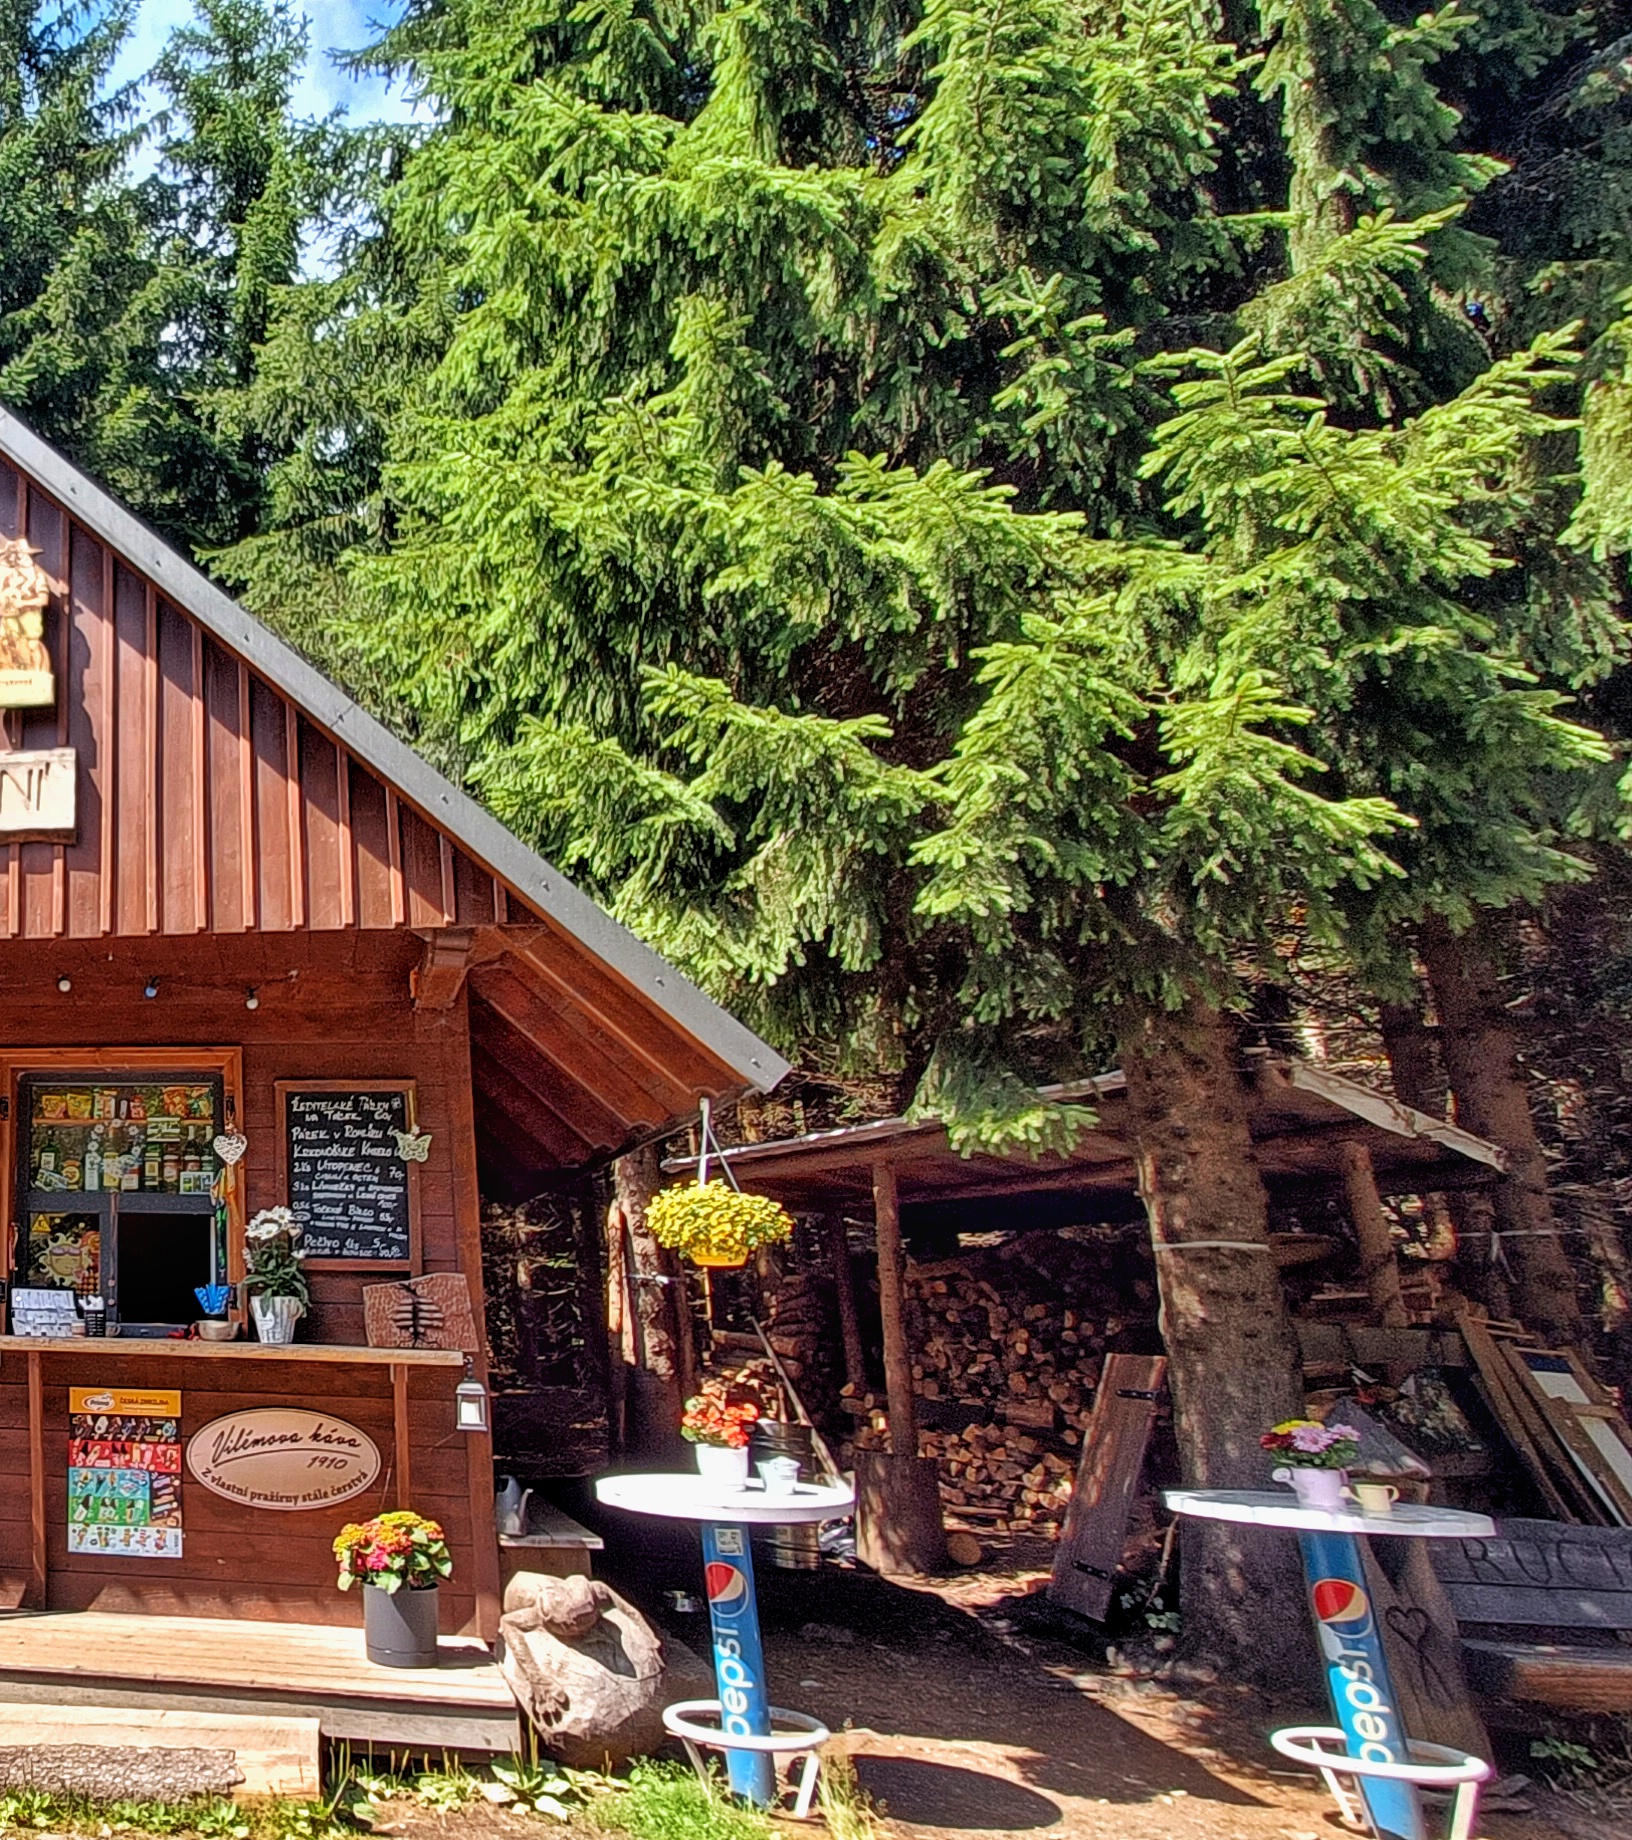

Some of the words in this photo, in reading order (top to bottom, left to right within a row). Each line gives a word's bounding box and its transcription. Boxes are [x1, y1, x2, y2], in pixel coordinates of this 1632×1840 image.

[212, 1425, 304, 1464] Vilémova
[308, 1423, 361, 1448] káva
[307, 1456, 348, 1470] 1910
[211, 1476, 248, 1497] vlastní
[250, 1491, 300, 1506] pražírny
[302, 1489, 329, 1502] stále
[331, 1469, 368, 1496] čerstvá
